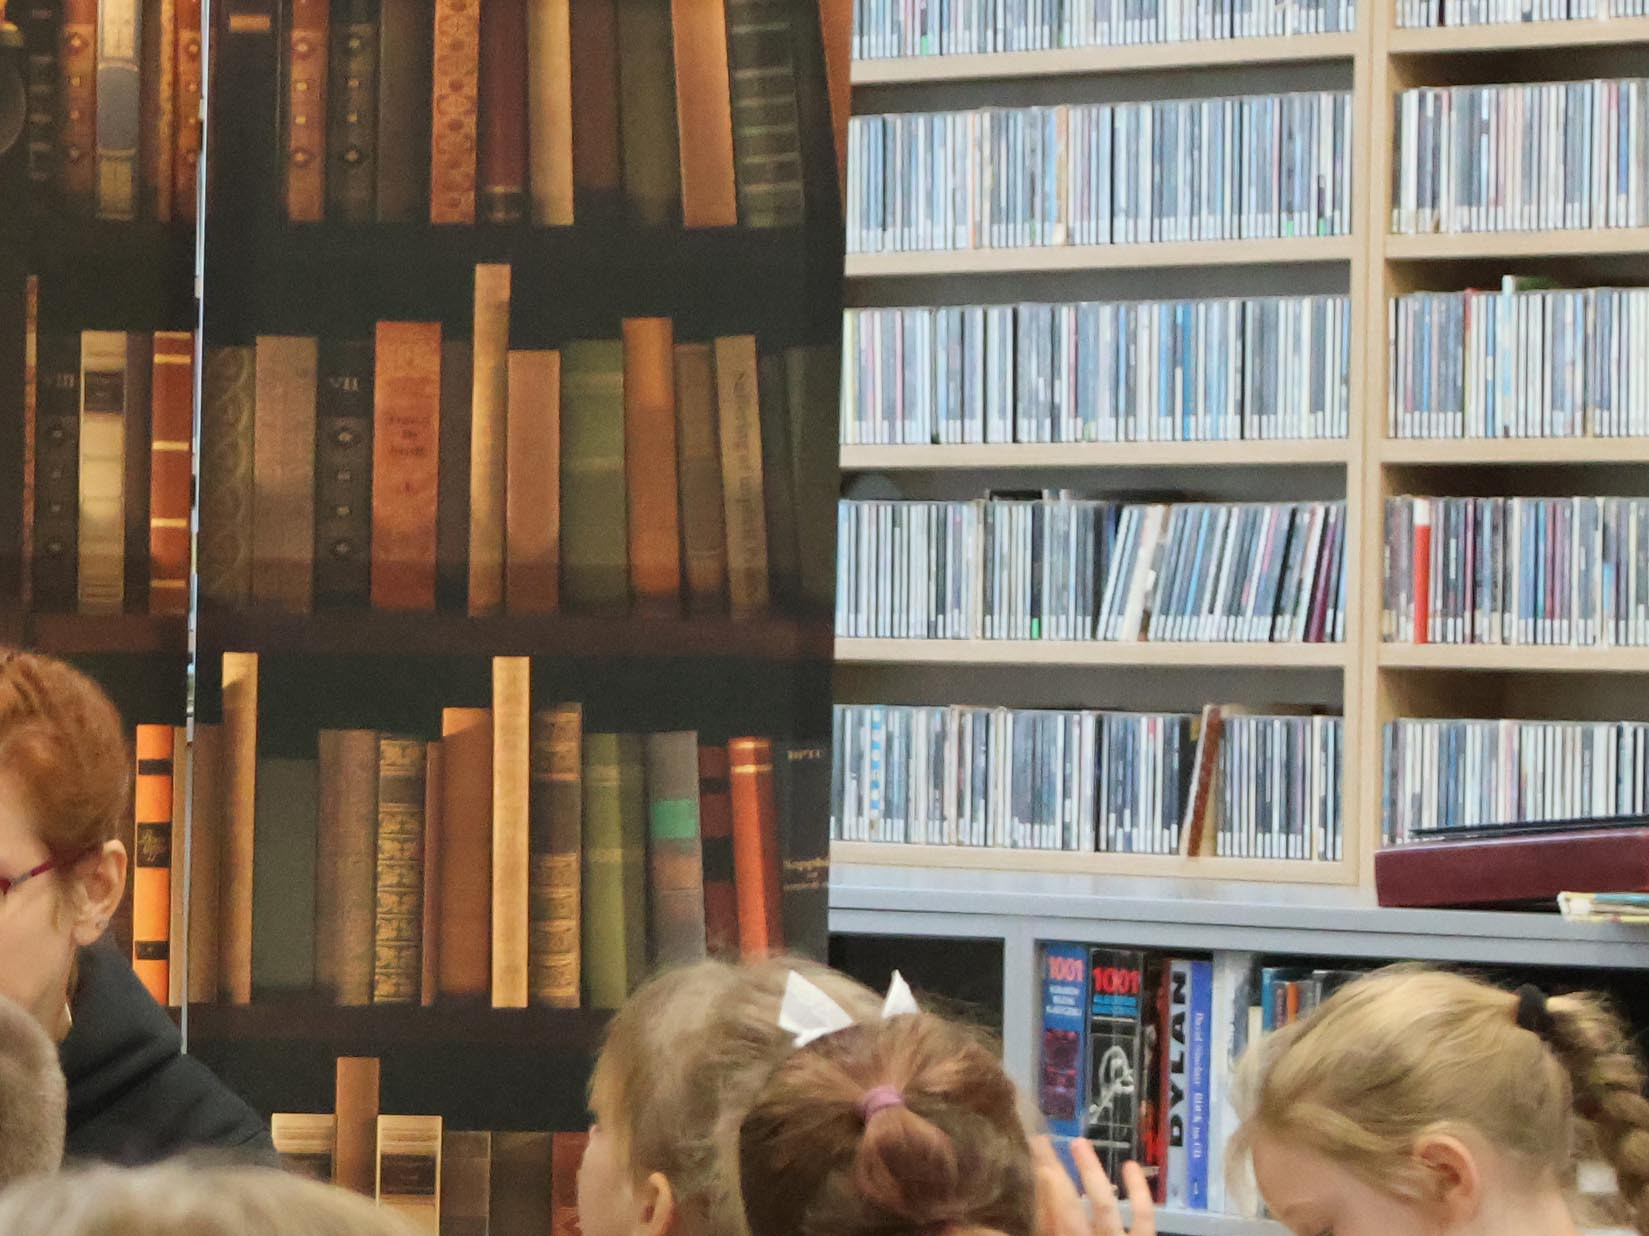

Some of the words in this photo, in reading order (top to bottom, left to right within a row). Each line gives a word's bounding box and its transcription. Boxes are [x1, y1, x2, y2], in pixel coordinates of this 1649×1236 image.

[1049, 956, 1084, 982] 1001
[1092, 967, 1140, 994] 1001
[1171, 970, 1188, 1148] DYLAN
